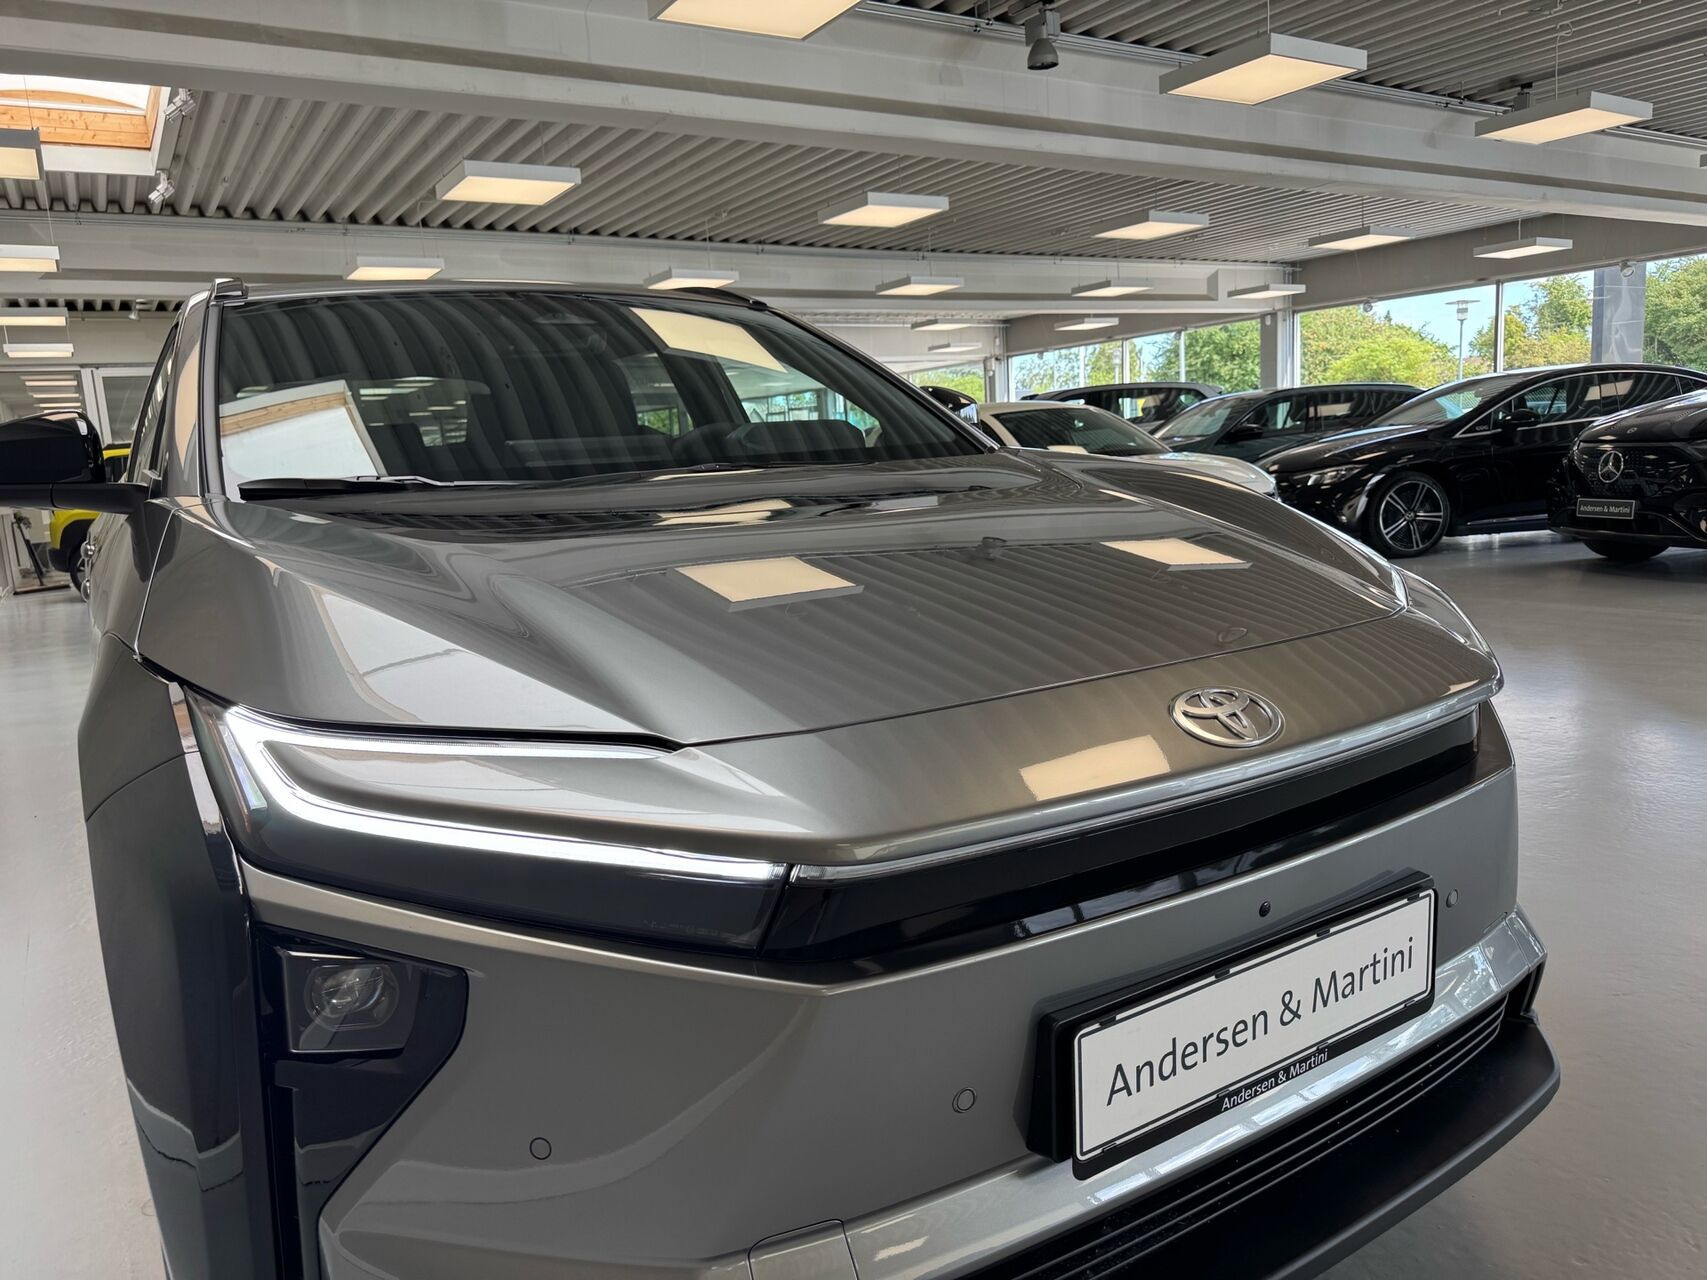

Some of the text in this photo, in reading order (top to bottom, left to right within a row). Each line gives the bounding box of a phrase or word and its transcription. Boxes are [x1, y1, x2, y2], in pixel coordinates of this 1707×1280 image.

[1580, 504, 1603, 512] Andersen
[1609, 505, 1630, 513] Martini
[1106, 936, 1414, 1107] Andersen & Martini
[1221, 1049, 1328, 1111] Andersen & Martini
